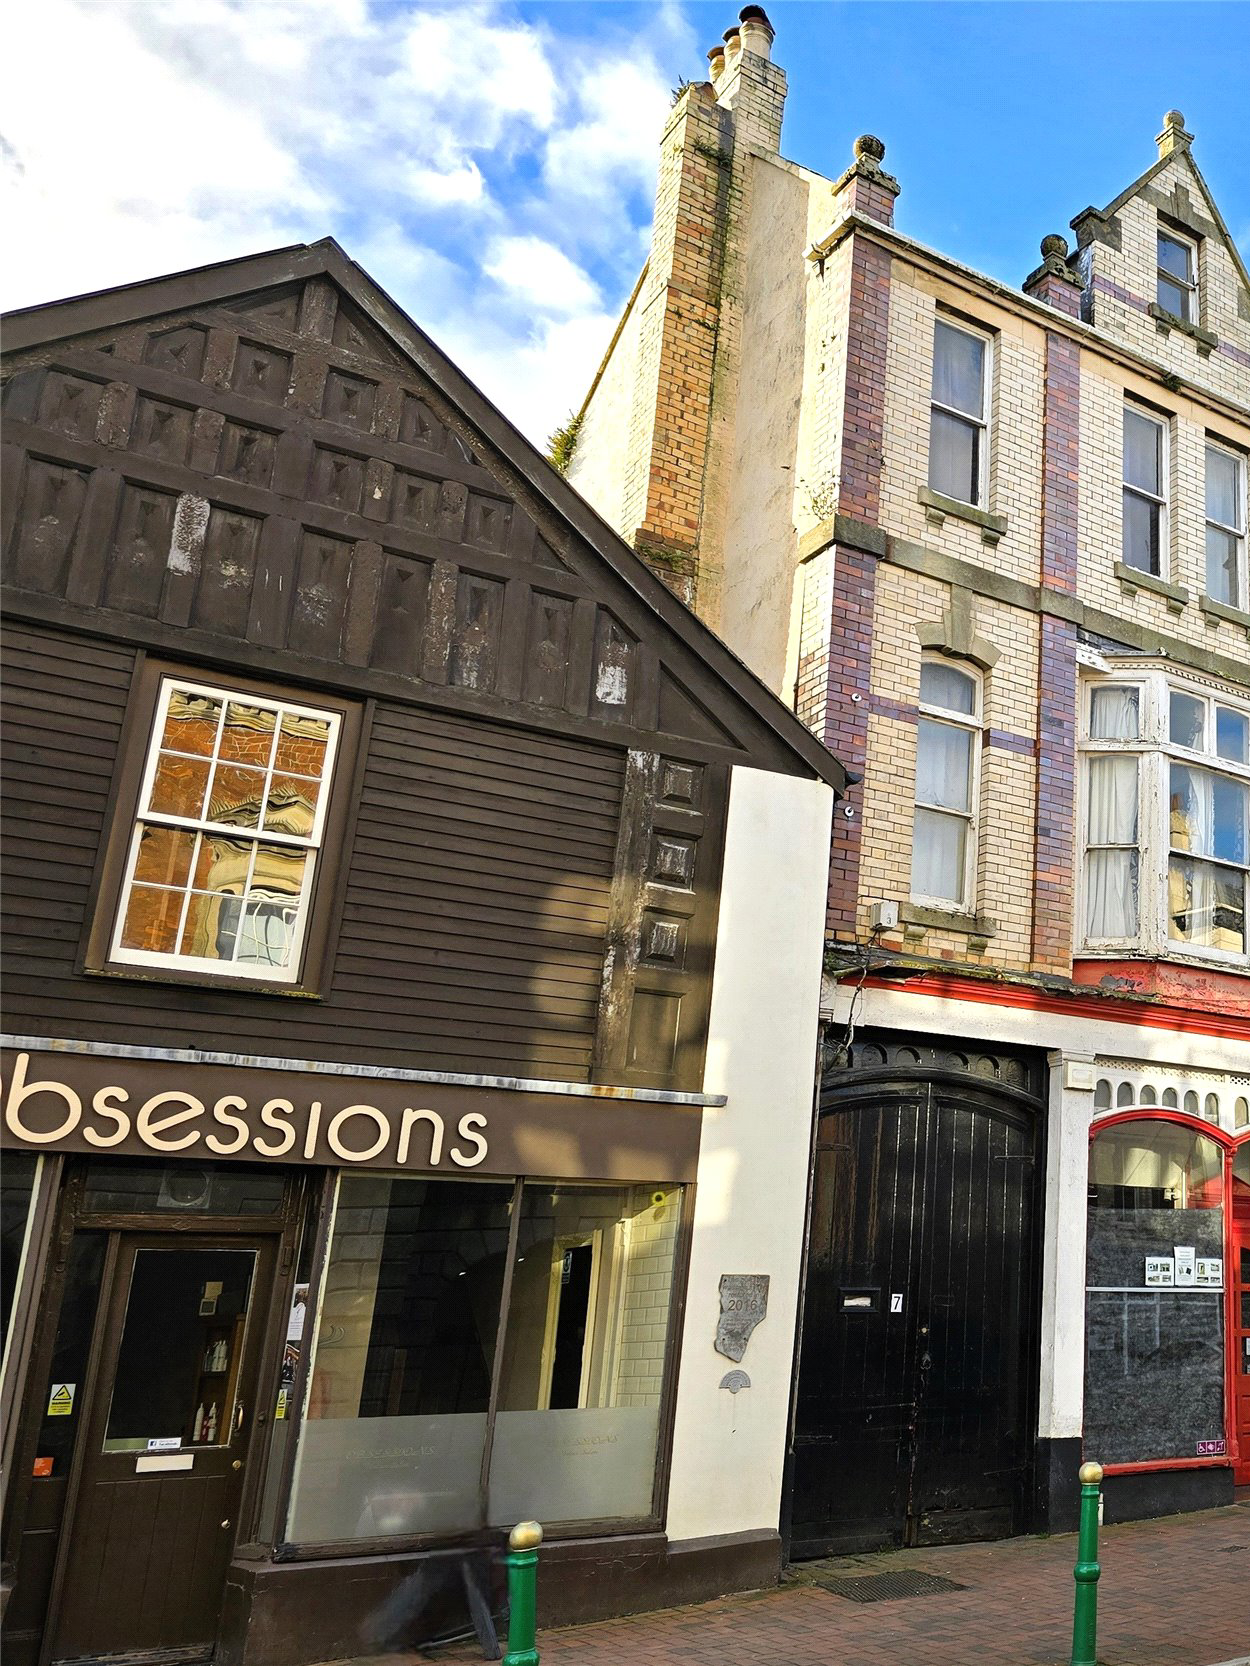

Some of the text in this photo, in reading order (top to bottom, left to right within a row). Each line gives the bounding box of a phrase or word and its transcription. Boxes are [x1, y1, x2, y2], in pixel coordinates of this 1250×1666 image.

[0, 1053, 488, 1167] bsessions
[728, 1300, 758, 1312] 2016
[893, 1295, 901, 1310] 7
